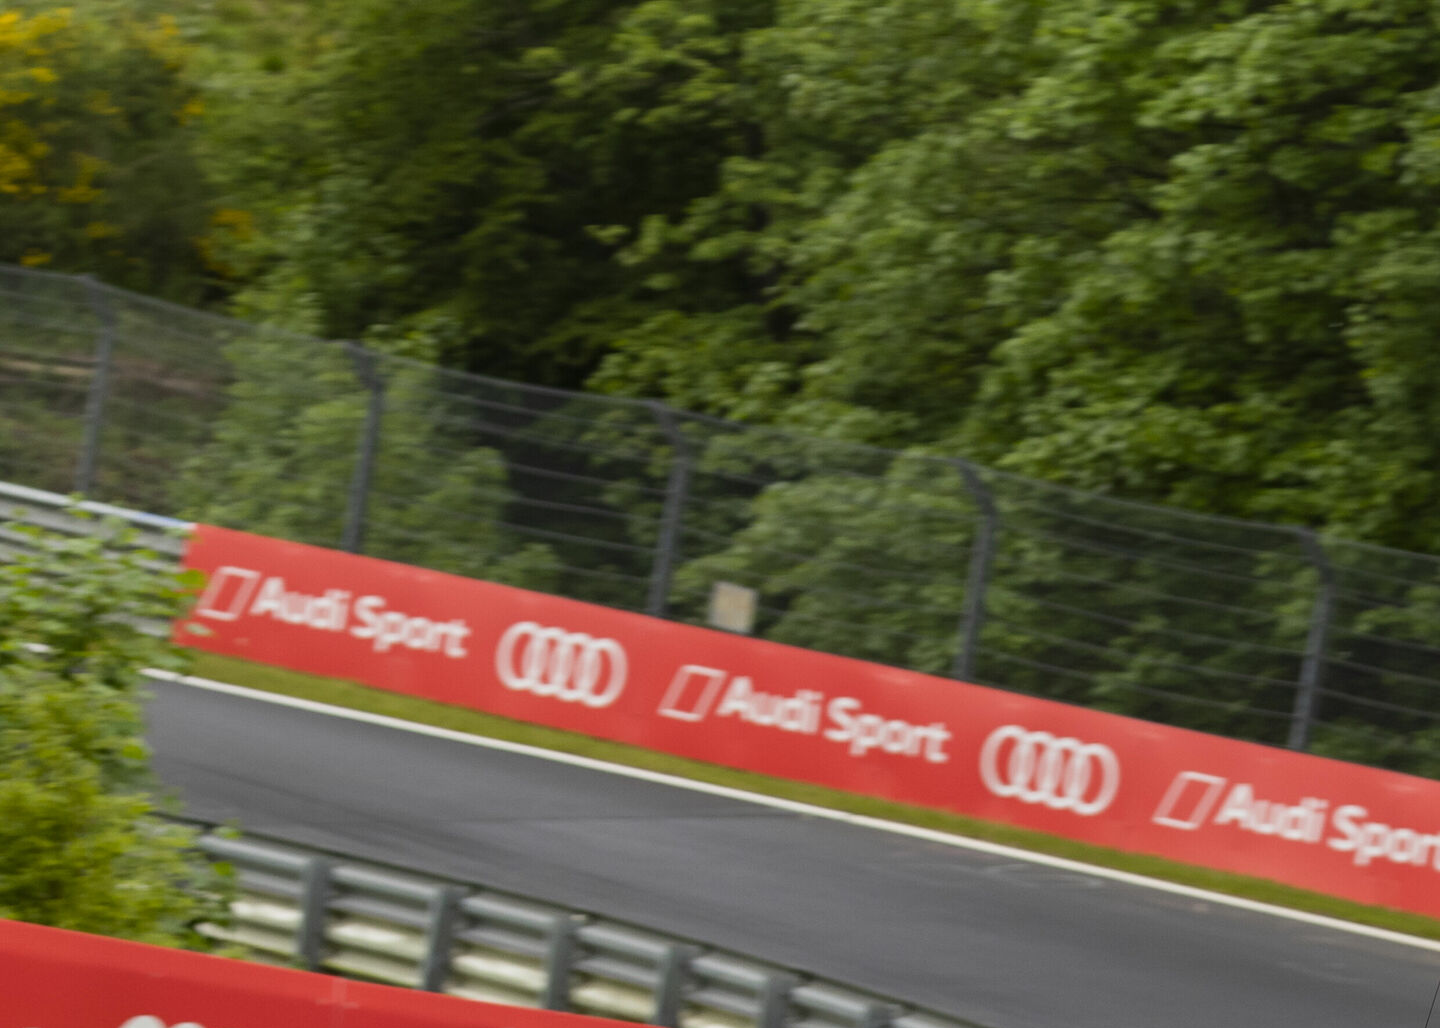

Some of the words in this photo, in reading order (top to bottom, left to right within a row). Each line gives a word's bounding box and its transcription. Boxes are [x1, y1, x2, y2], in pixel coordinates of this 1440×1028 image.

[250, 577, 351, 631] Audi
[350, 595, 472, 658] Sport
[715, 676, 823, 734] Audi
[823, 696, 952, 763] Sport
[1213, 783, 1329, 843] Audi
